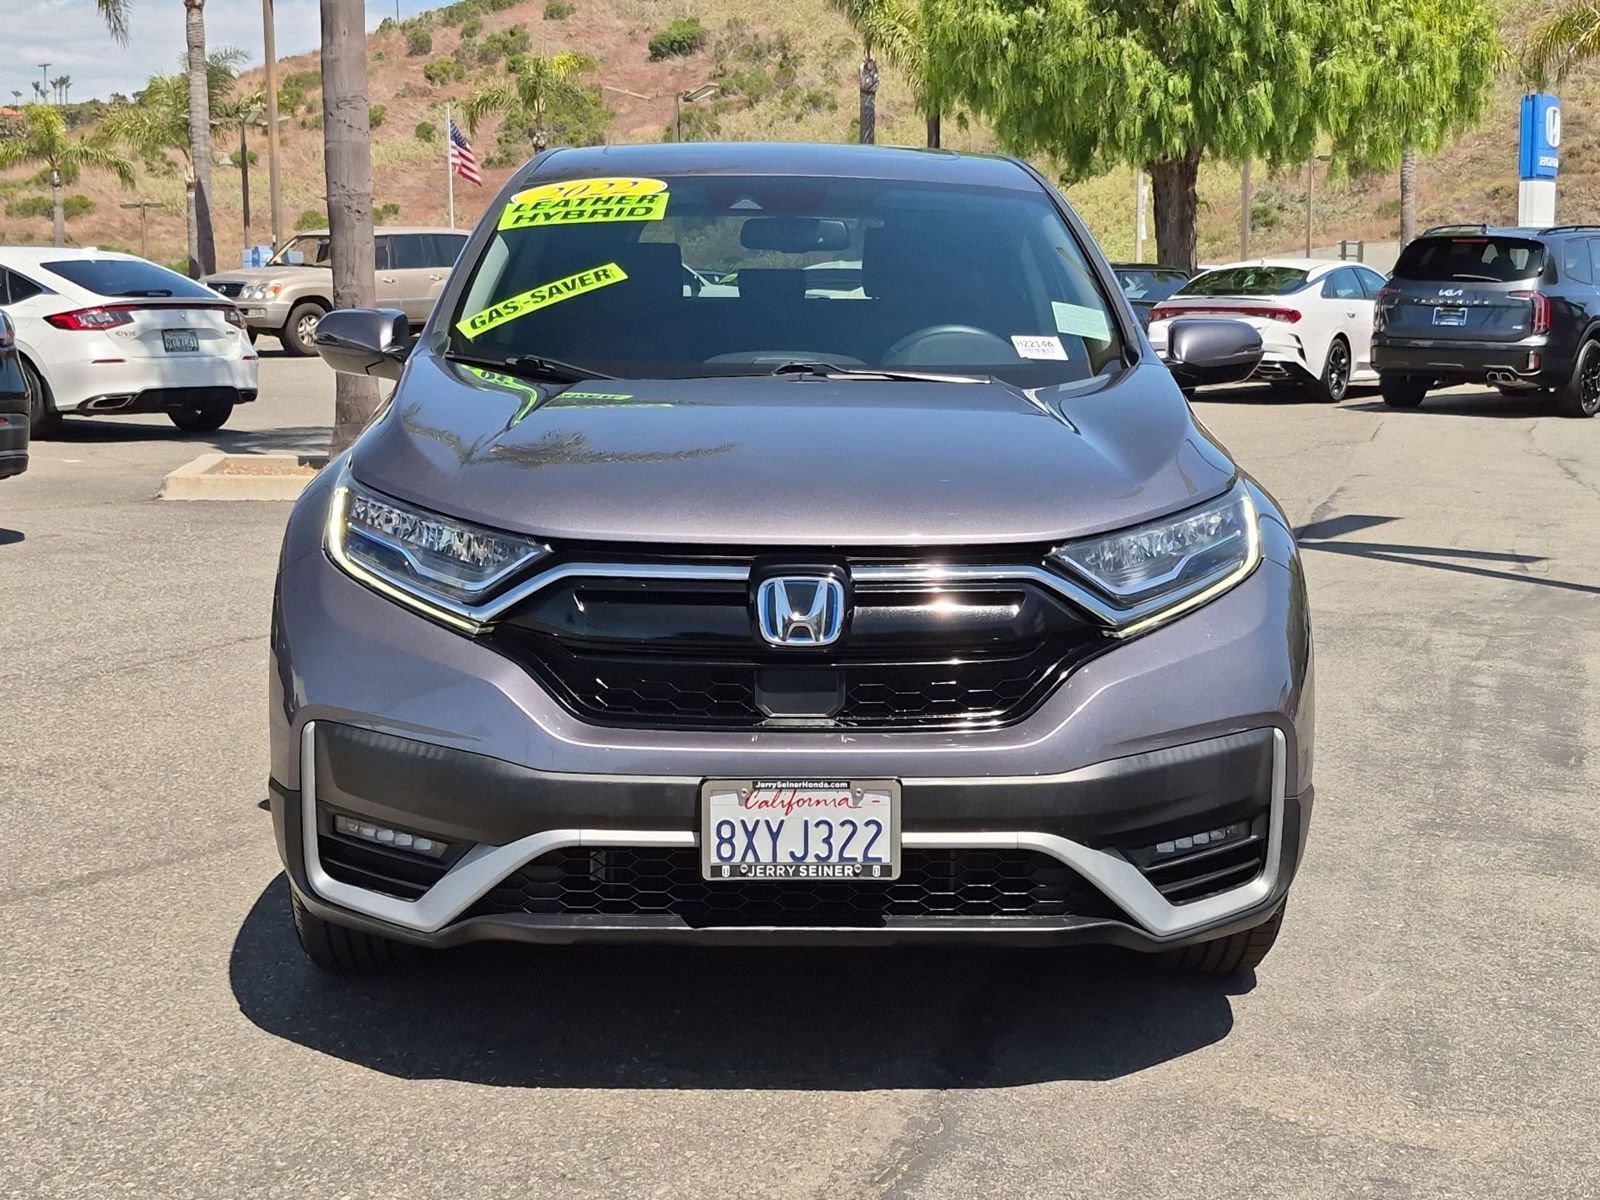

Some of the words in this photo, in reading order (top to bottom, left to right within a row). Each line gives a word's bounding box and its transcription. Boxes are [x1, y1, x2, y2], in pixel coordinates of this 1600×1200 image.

[512, 194, 660, 213] LEATHER
[512, 206, 654, 225] HYBRID
[469, 267, 612, 331] GAS-SAVER
[755, 780, 849, 790] JerrySeinerHonda.com
[744, 789, 863, 816] California
[715, 819, 883, 863] 8XYJ322
[747, 865, 796, 877] JERRY
[799, 865, 854, 877] SEINER
